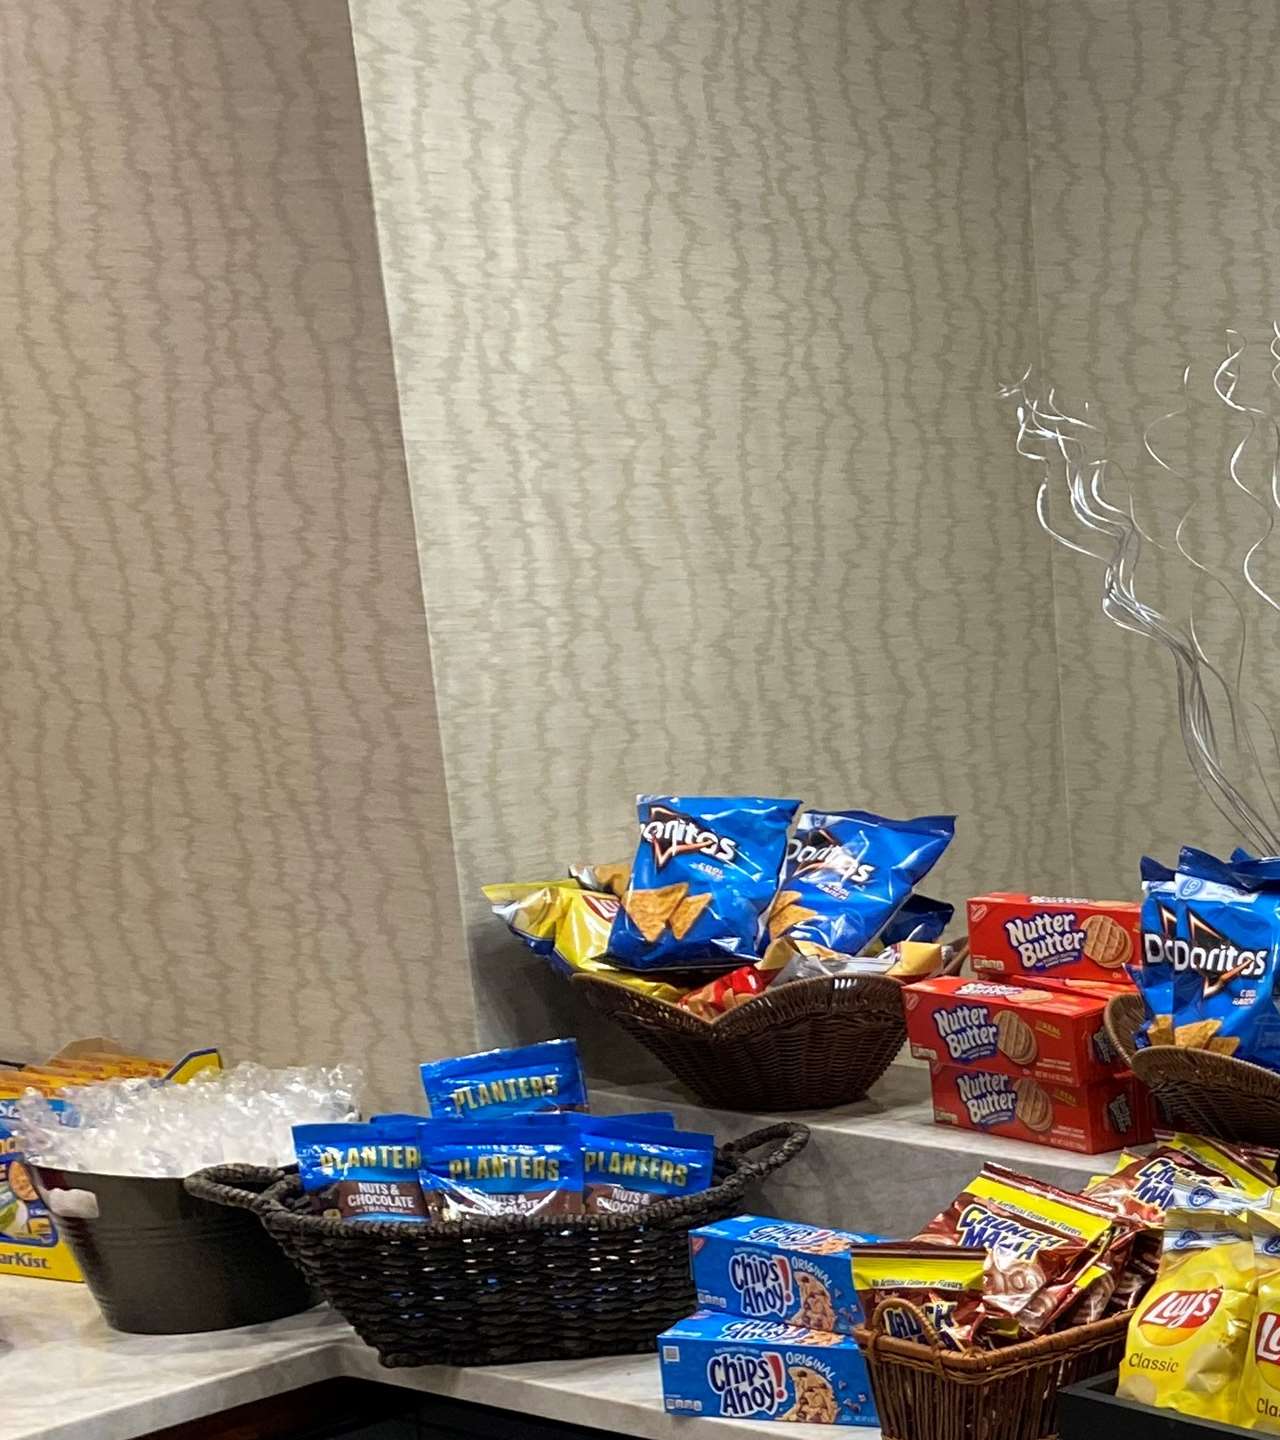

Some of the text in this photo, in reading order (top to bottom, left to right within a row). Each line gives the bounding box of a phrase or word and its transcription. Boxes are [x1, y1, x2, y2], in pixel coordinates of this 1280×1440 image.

[1005, 912, 1076, 945] Nutter
[1018, 930, 1086, 969] Butter
[1174, 940, 1267, 976] Doritos
[934, 1006, 988, 1034] Nutter
[946, 1025, 998, 1058] Butter
[454, 1075, 560, 1112] PLANTERS
[957, 1073, 1010, 1100] Nutter
[966, 1091, 1017, 1124] Butter
[320, 1146, 420, 1170] PLANTER
[449, 1155, 560, 1181] PLANTERS
[584, 1150, 688, 1187] PLANTERS
[348, 1193, 415, 1209] CHOCOLATE
[358, 1182, 389, 1195] NUTS
[0, 1252, 50, 1269] arKist
[730, 1254, 779, 1287] Chips
[791, 1256, 832, 1289] ORIGINAL
[1143, 1290, 1220, 1329] Lay's
[708, 1354, 770, 1386] Chips
[1129, 1352, 1180, 1373] Classic
